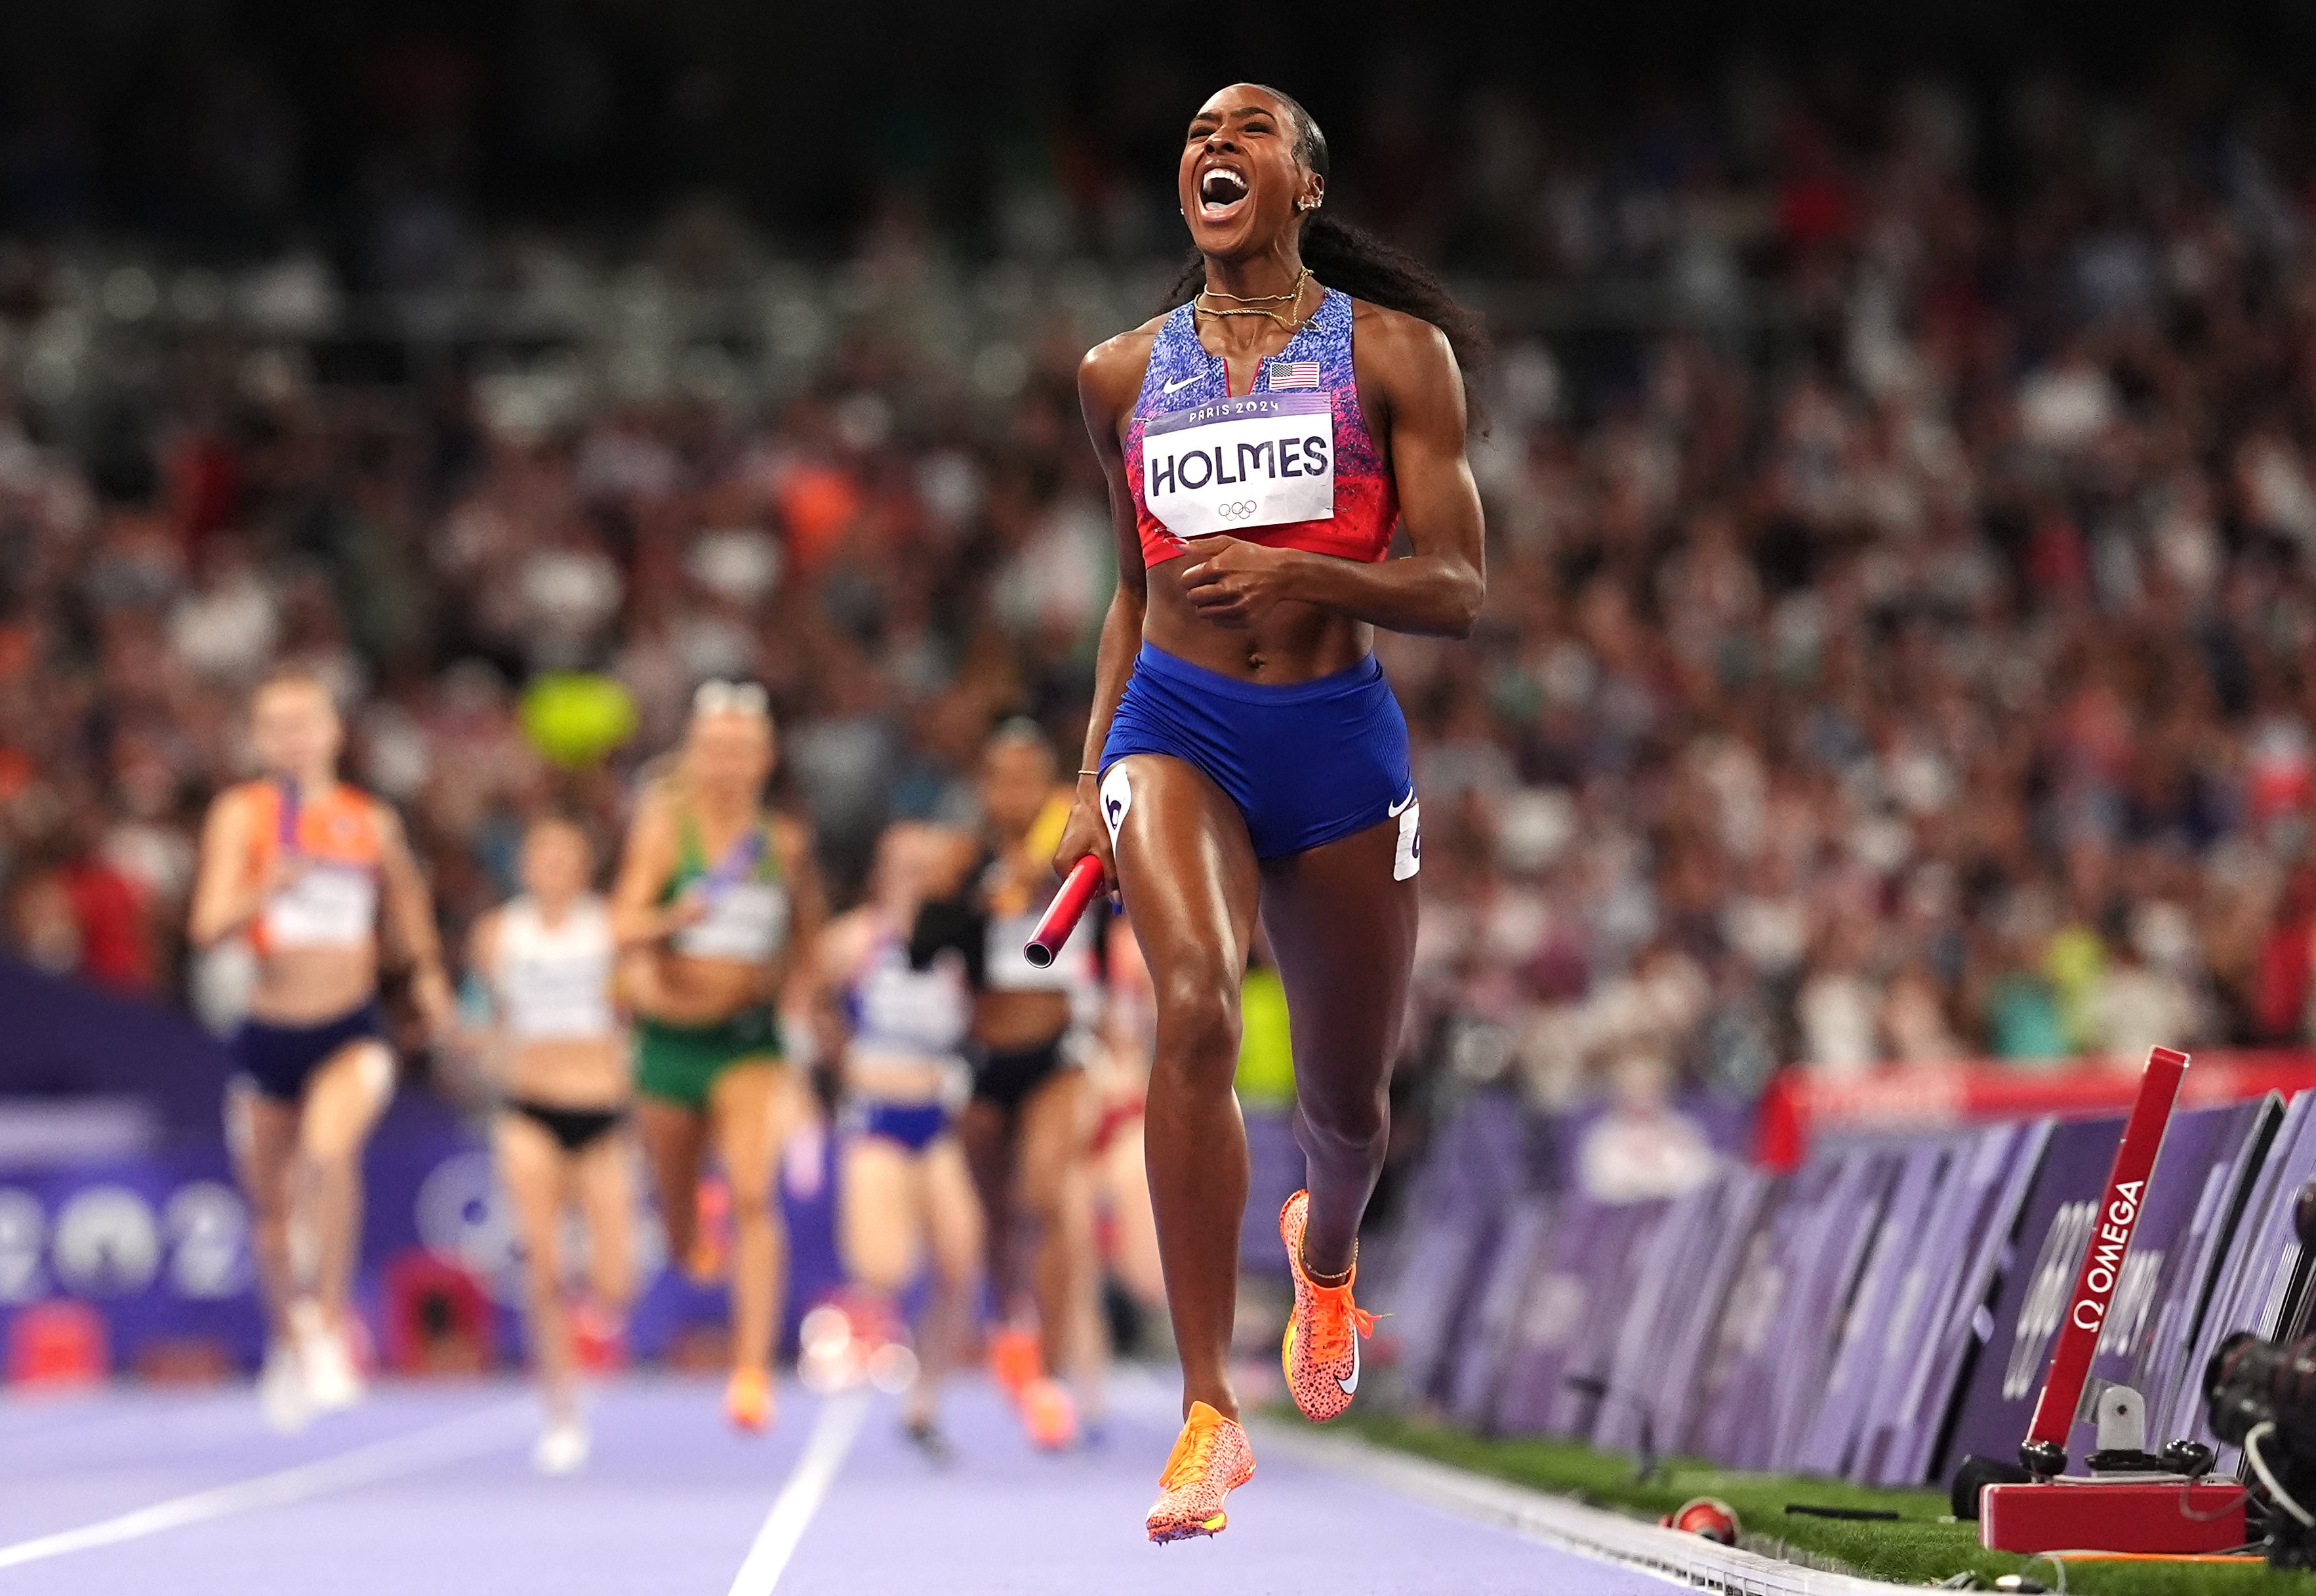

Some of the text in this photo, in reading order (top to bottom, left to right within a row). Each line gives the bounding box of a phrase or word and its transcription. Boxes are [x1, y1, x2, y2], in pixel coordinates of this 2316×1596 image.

[1189, 400, 1278, 422] PARIS 2024
[1152, 436, 1328, 497] HOLMES
[2087, 1181, 2144, 1293] OMEGA
